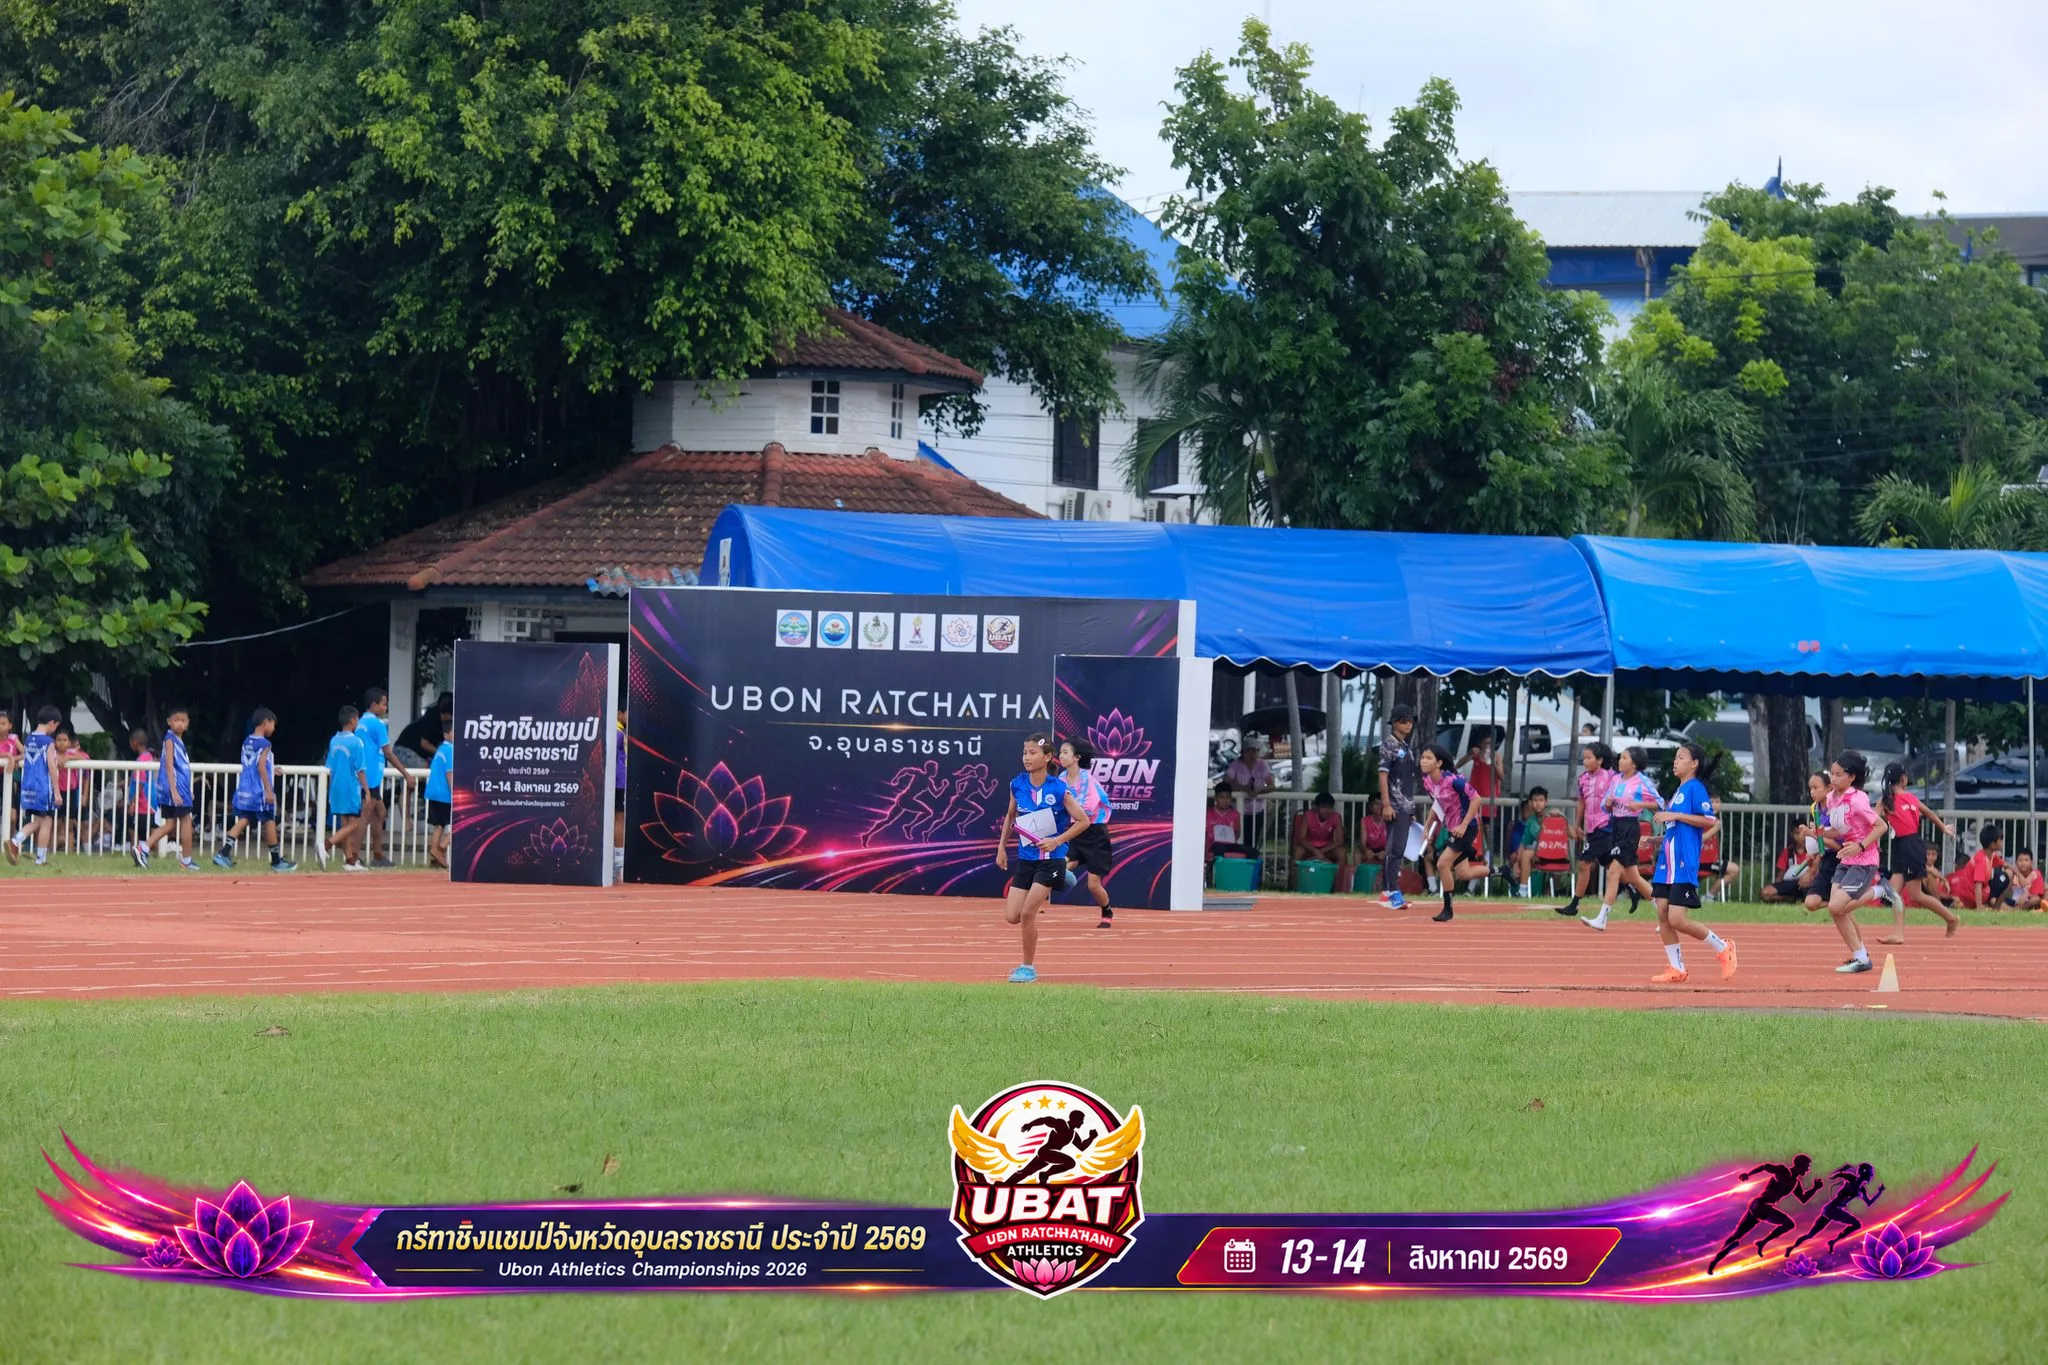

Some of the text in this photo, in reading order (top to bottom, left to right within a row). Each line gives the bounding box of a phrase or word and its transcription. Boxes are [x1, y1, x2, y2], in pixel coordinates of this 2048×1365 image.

[711, 685, 1051, 720] UBON RATCHATHA
[479, 743, 579, 764] จ.อุบลราชธานี
[808, 734, 982, 758] จ.อุบลราชธานี
[532, 767, 550, 776] 2569
[479, 781, 580, 794] 12-14 สิงหาคม 2569
